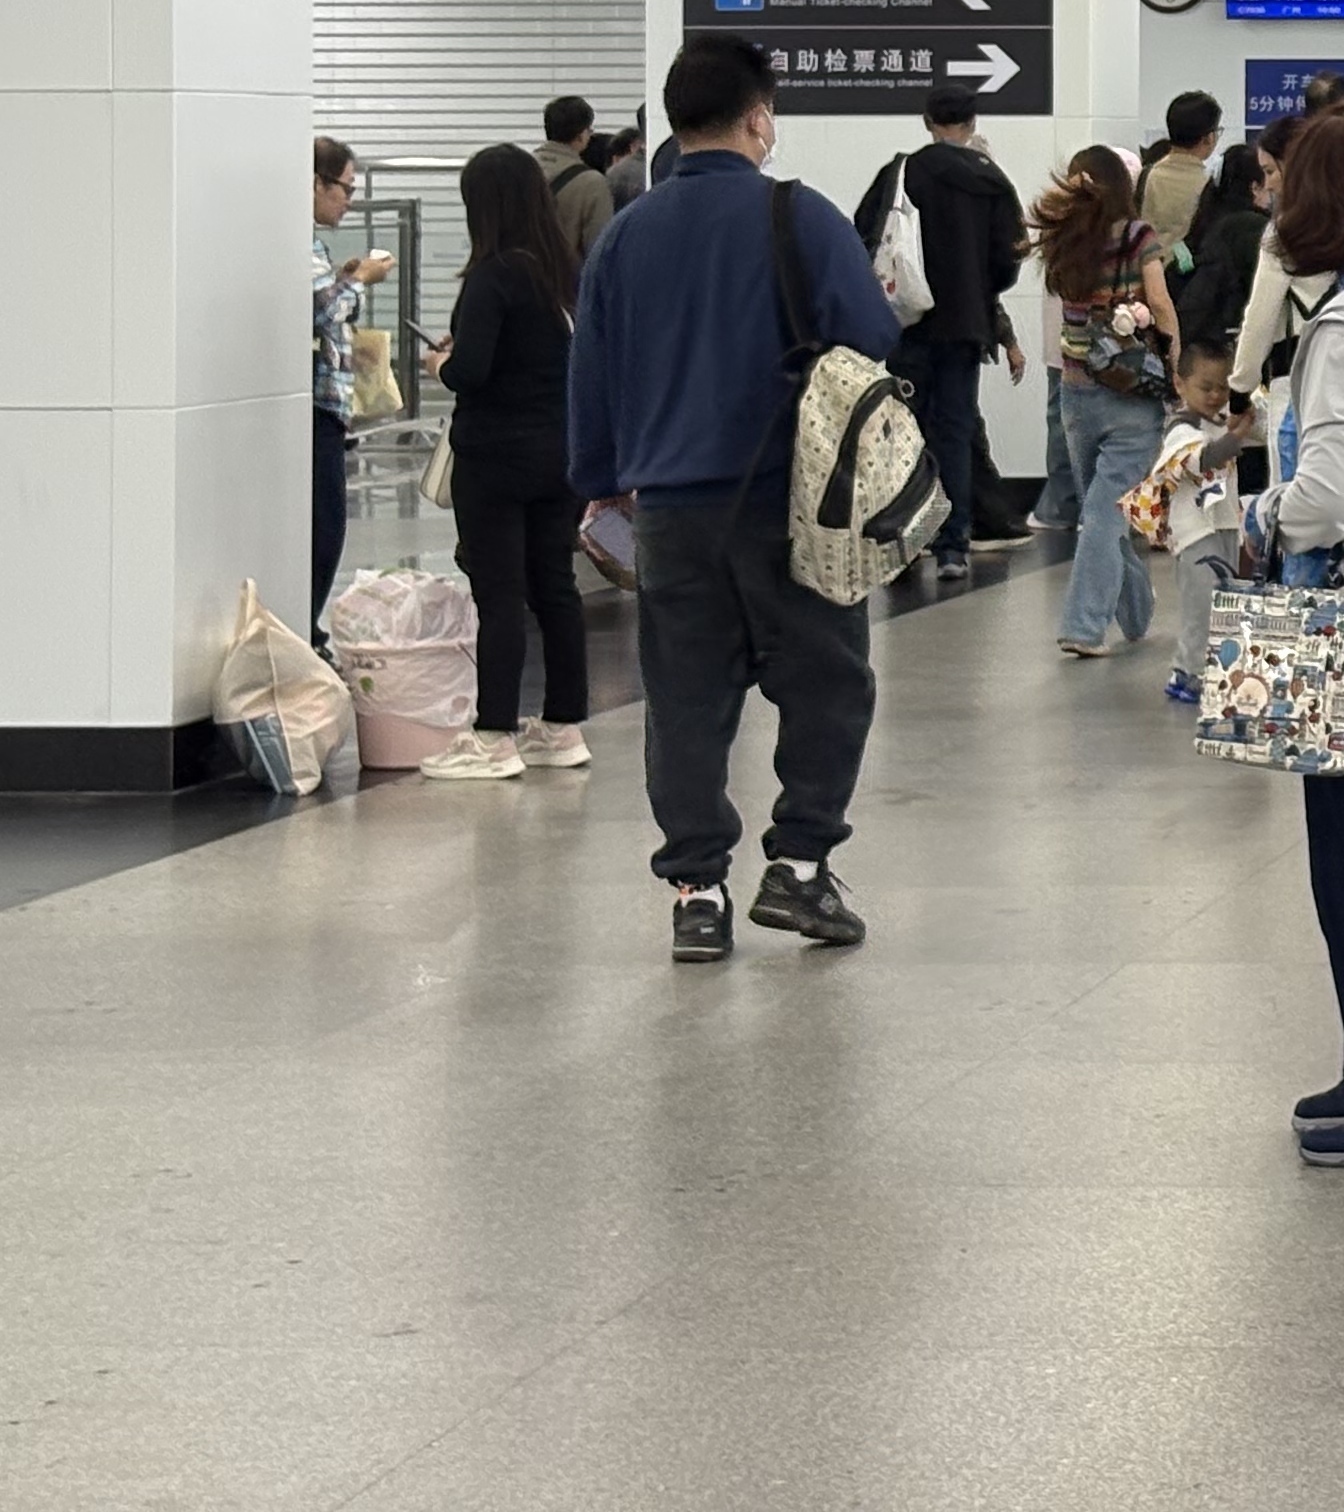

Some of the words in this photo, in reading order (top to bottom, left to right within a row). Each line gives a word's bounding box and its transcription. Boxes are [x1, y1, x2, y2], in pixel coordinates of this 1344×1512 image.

[770, 48, 934, 73] 自助检票通道
[776, 78, 825, 87] elf-service
[896, 78, 933, 87] channel
[1282, 73, 1315, 91] 开车
